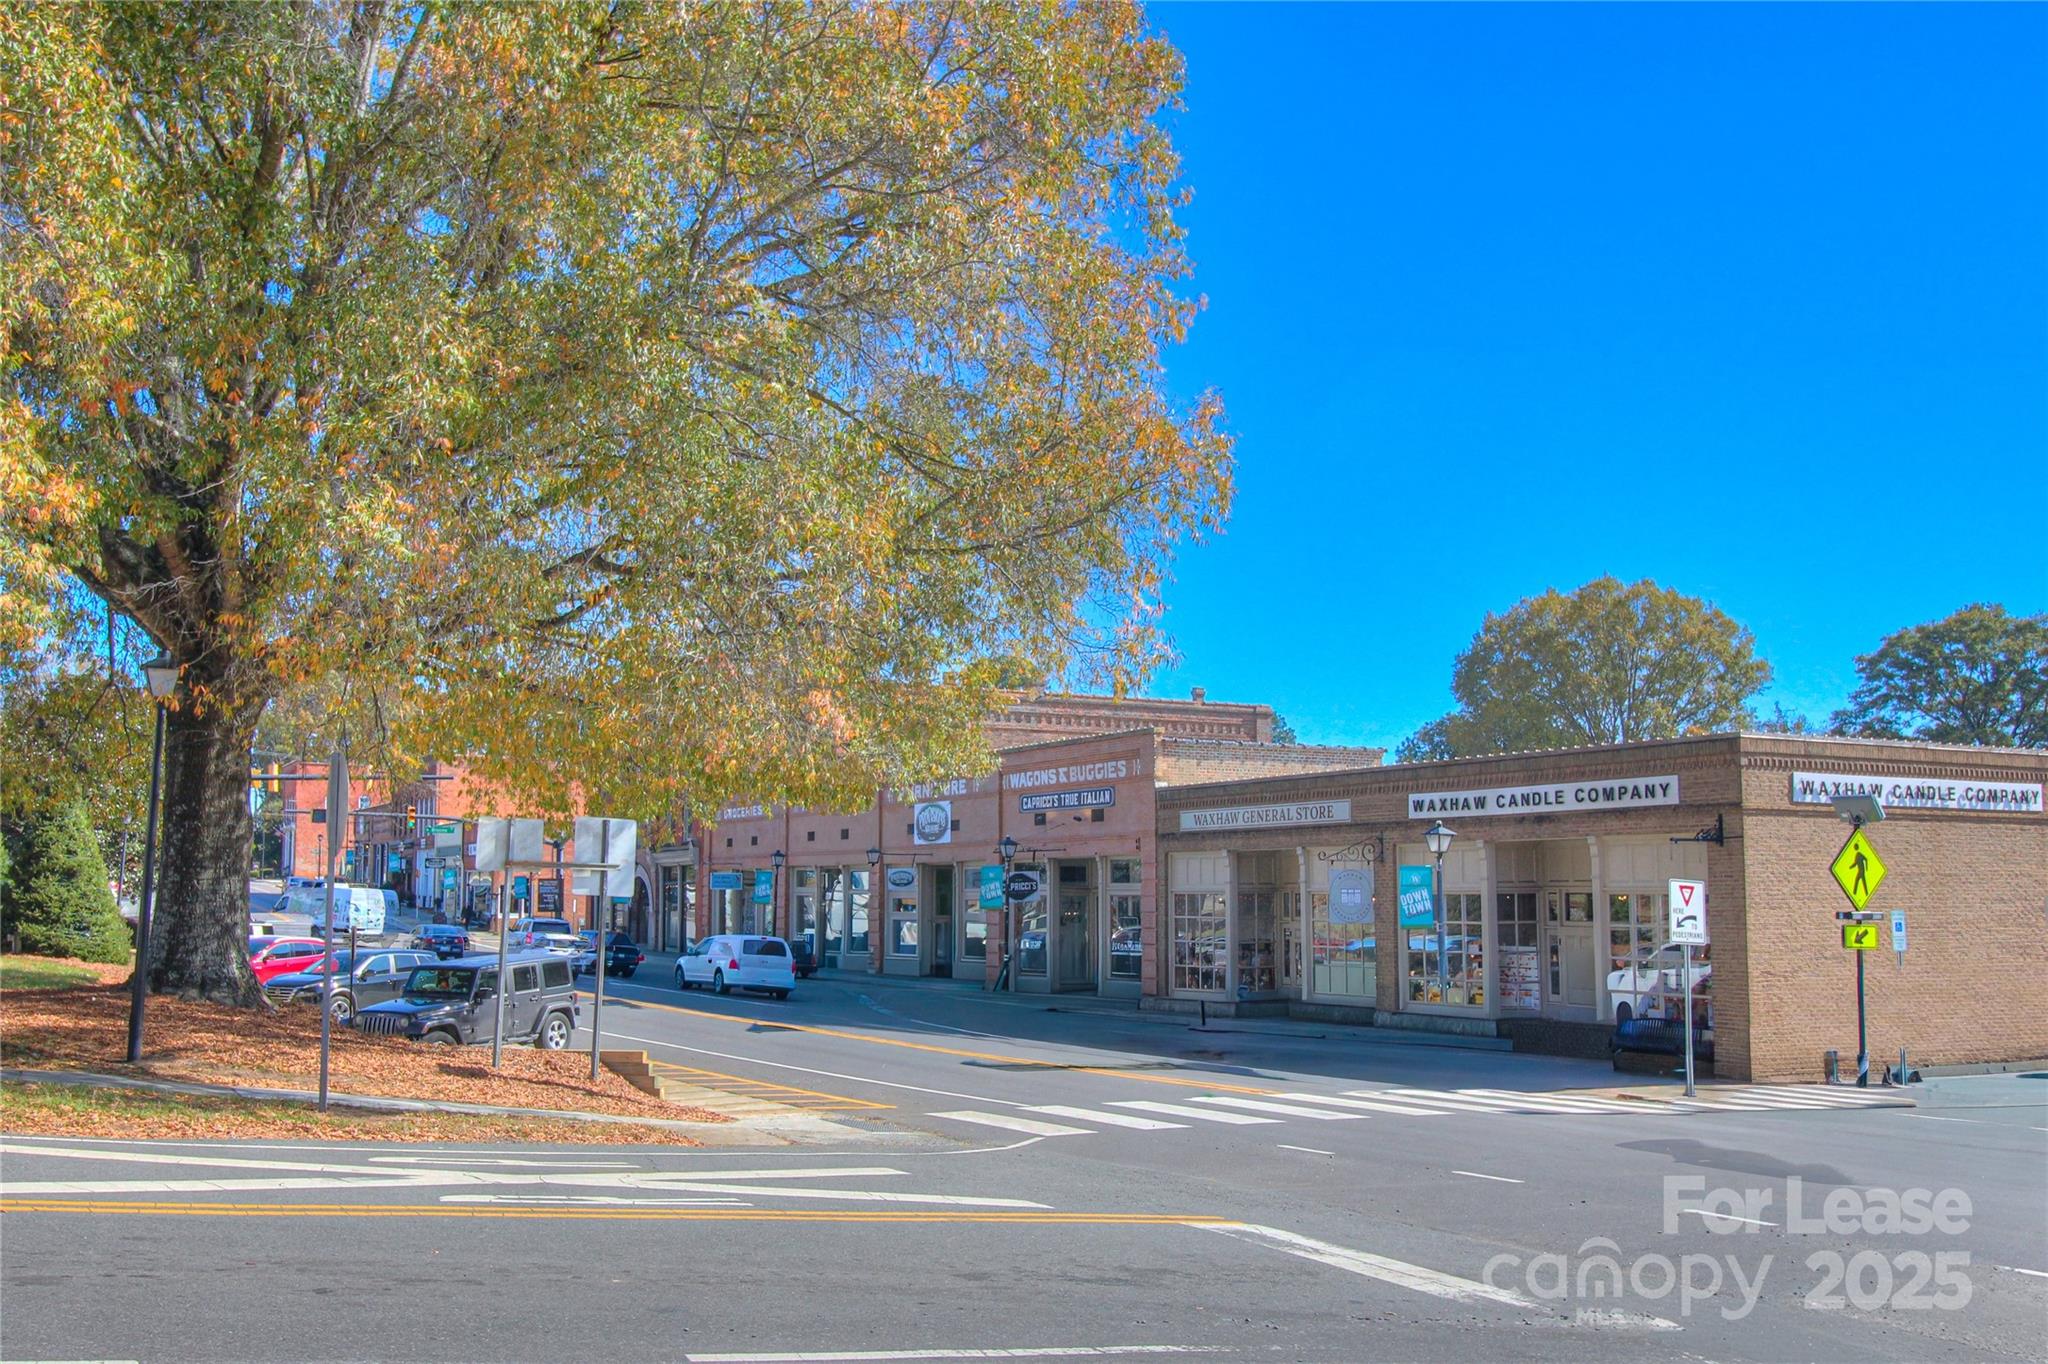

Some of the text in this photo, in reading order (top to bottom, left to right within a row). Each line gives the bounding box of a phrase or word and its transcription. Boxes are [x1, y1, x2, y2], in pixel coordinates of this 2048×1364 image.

[1010, 760, 1127, 789] WAGONS & BUGGIES
[1022, 789, 1111, 810] CAPRICCI'S TRUE ITALIAN
[1413, 783, 1671, 813] WAXHAW CANDLE COMPANY
[1801, 780, 2040, 805] WAXHAW CANDLE COMPANY
[1194, 804, 1335, 827] WAXHAW GENERAL STORE
[1010, 881, 1037, 891] PRICCI'S
[1400, 886, 1429, 906] DOWN
[1402, 898, 1432, 917] TOWN
